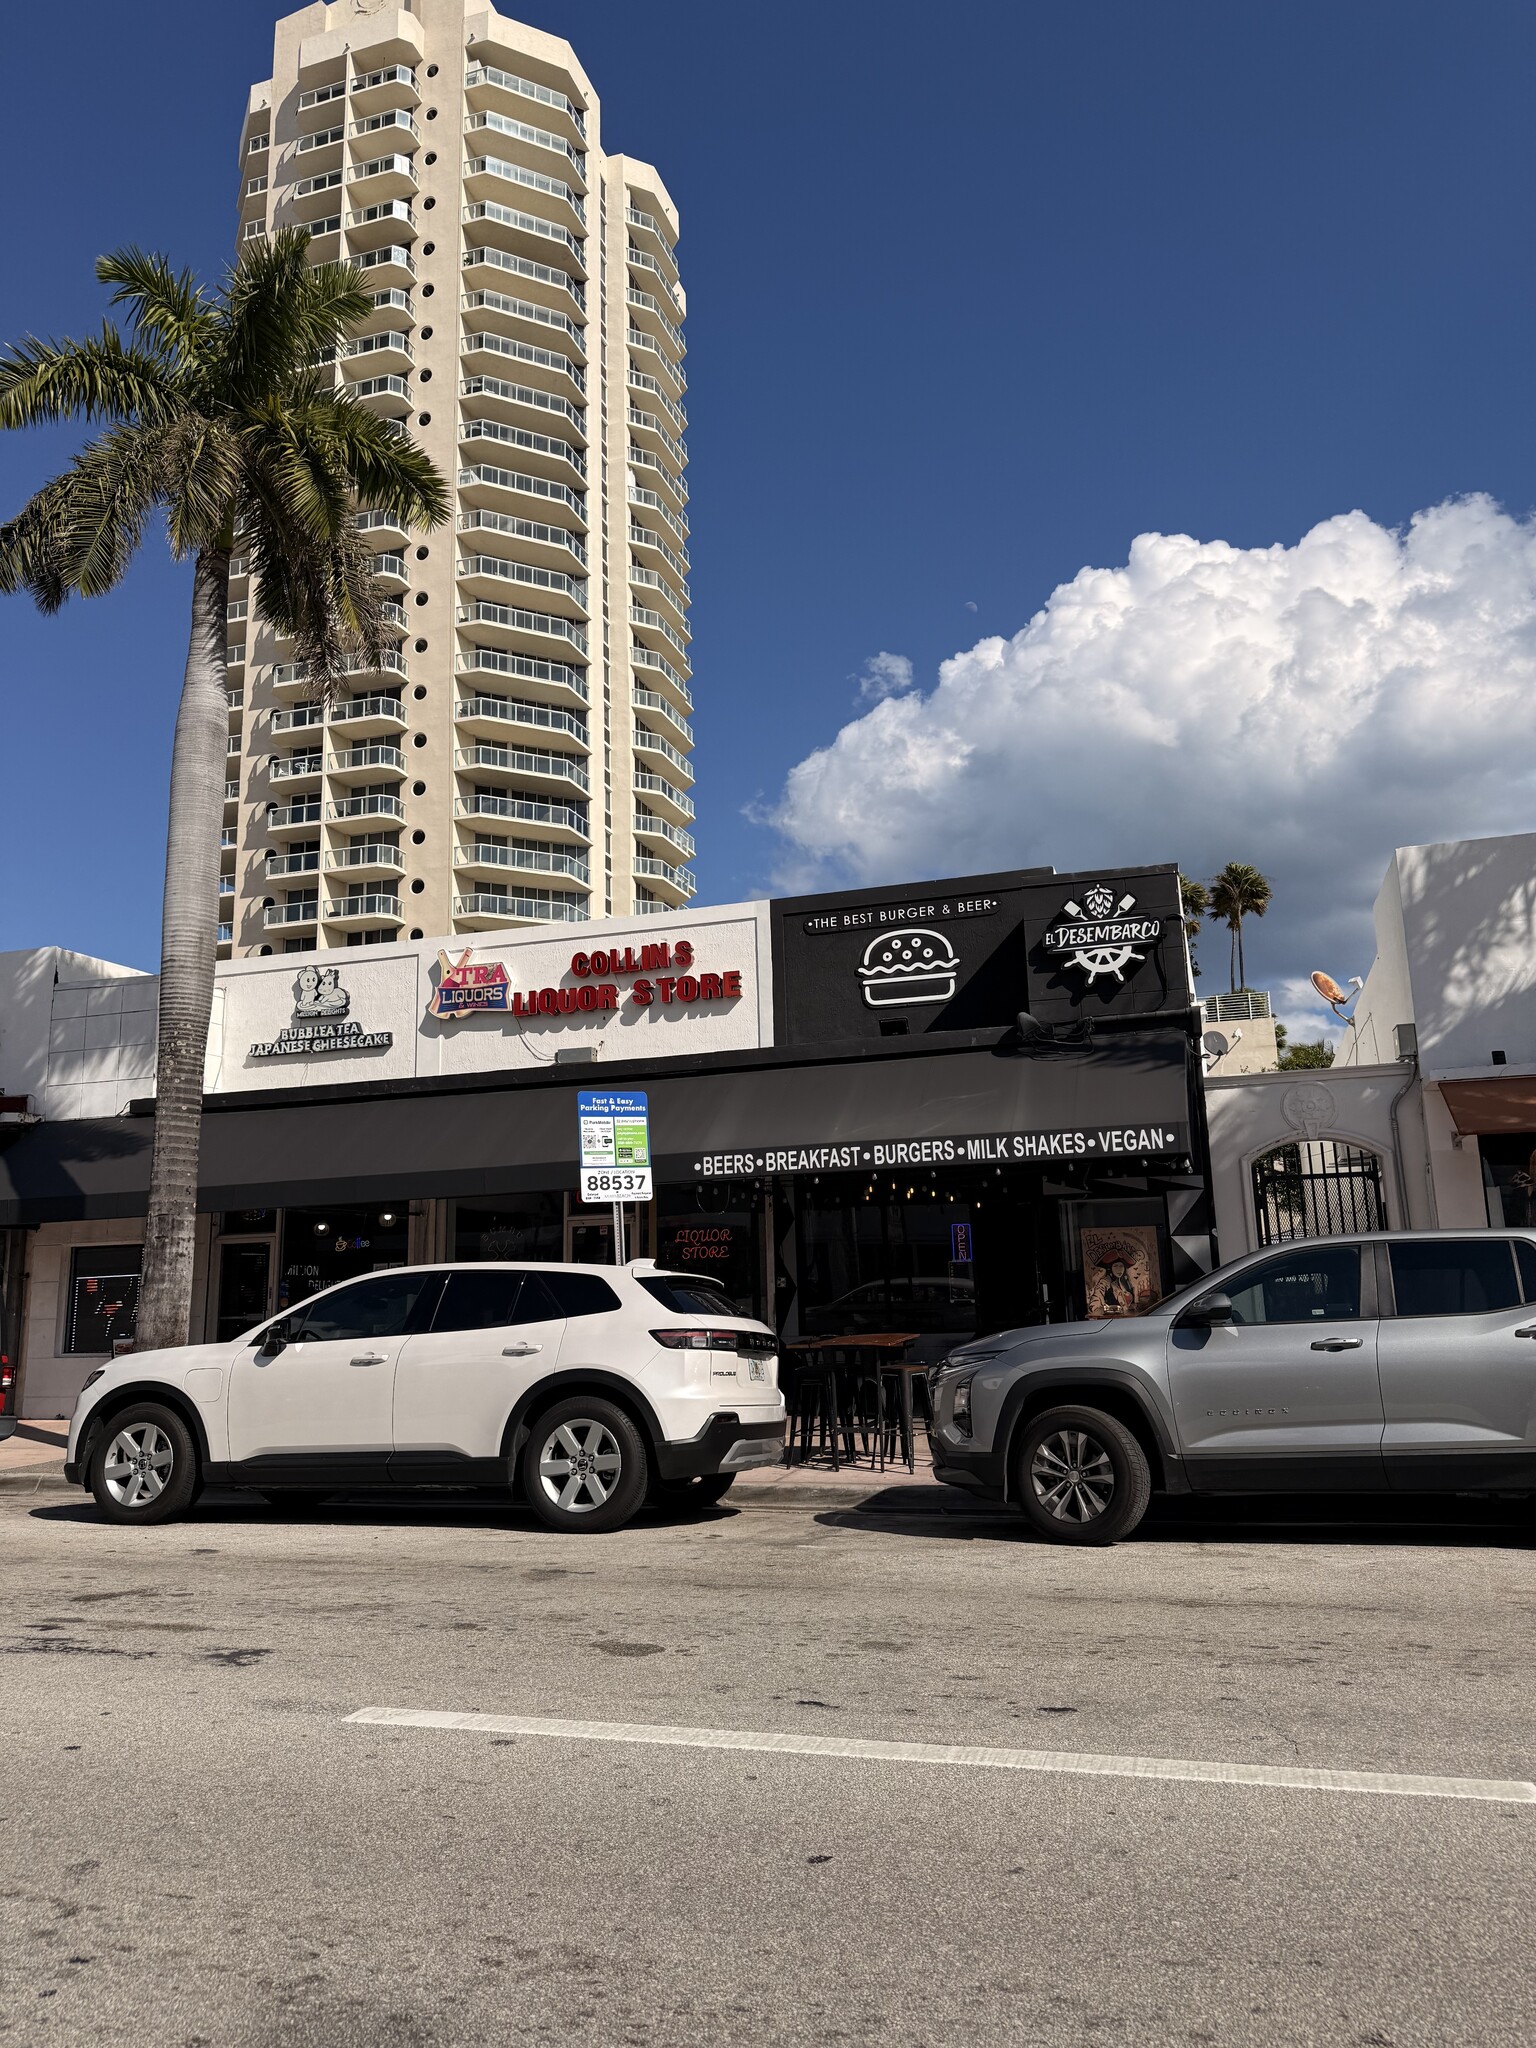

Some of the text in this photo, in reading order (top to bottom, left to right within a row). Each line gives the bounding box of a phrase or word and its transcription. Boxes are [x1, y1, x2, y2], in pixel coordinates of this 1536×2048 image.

[814, 899, 991, 928] THE BEST BURGER & BEER
[1045, 920, 1160, 948] EL DESEMBARCO
[571, 941, 694, 979] COLLINS
[442, 987, 503, 1004] LIQUORS
[512, 970, 742, 1017] LIQUOR STORE
[337, 1022, 359, 1034] TEA
[249, 1033, 390, 1057] JAPANESE CHEESECAKE
[581, 1104, 646, 1112] Parking Payments
[592, 1097, 633, 1106] Fast & Easy
[703, 1128, 1164, 1176] BEERS BREAKFAST BURGERS MILK SHAKES VEGAN
[587, 1175, 646, 1191] 88537
[675, 1229, 733, 1246] LIQUOR
[957, 1224, 967, 1260] OPEN
[682, 1246, 730, 1260] STORE
